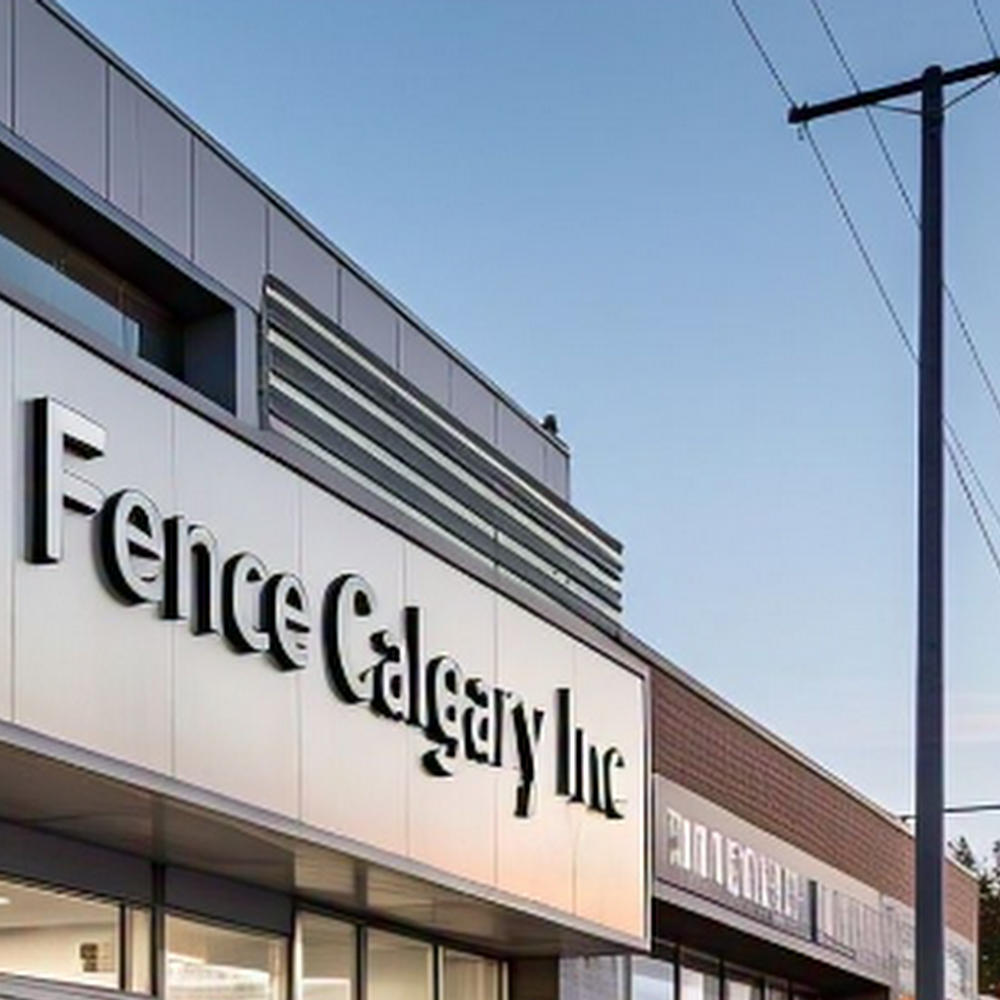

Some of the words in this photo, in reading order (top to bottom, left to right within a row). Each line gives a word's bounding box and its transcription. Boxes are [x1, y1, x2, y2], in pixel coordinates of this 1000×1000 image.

[24, 396, 310, 672] Fence
[321, 573, 546, 818] Calgary
[555, 687, 626, 819] Inc
